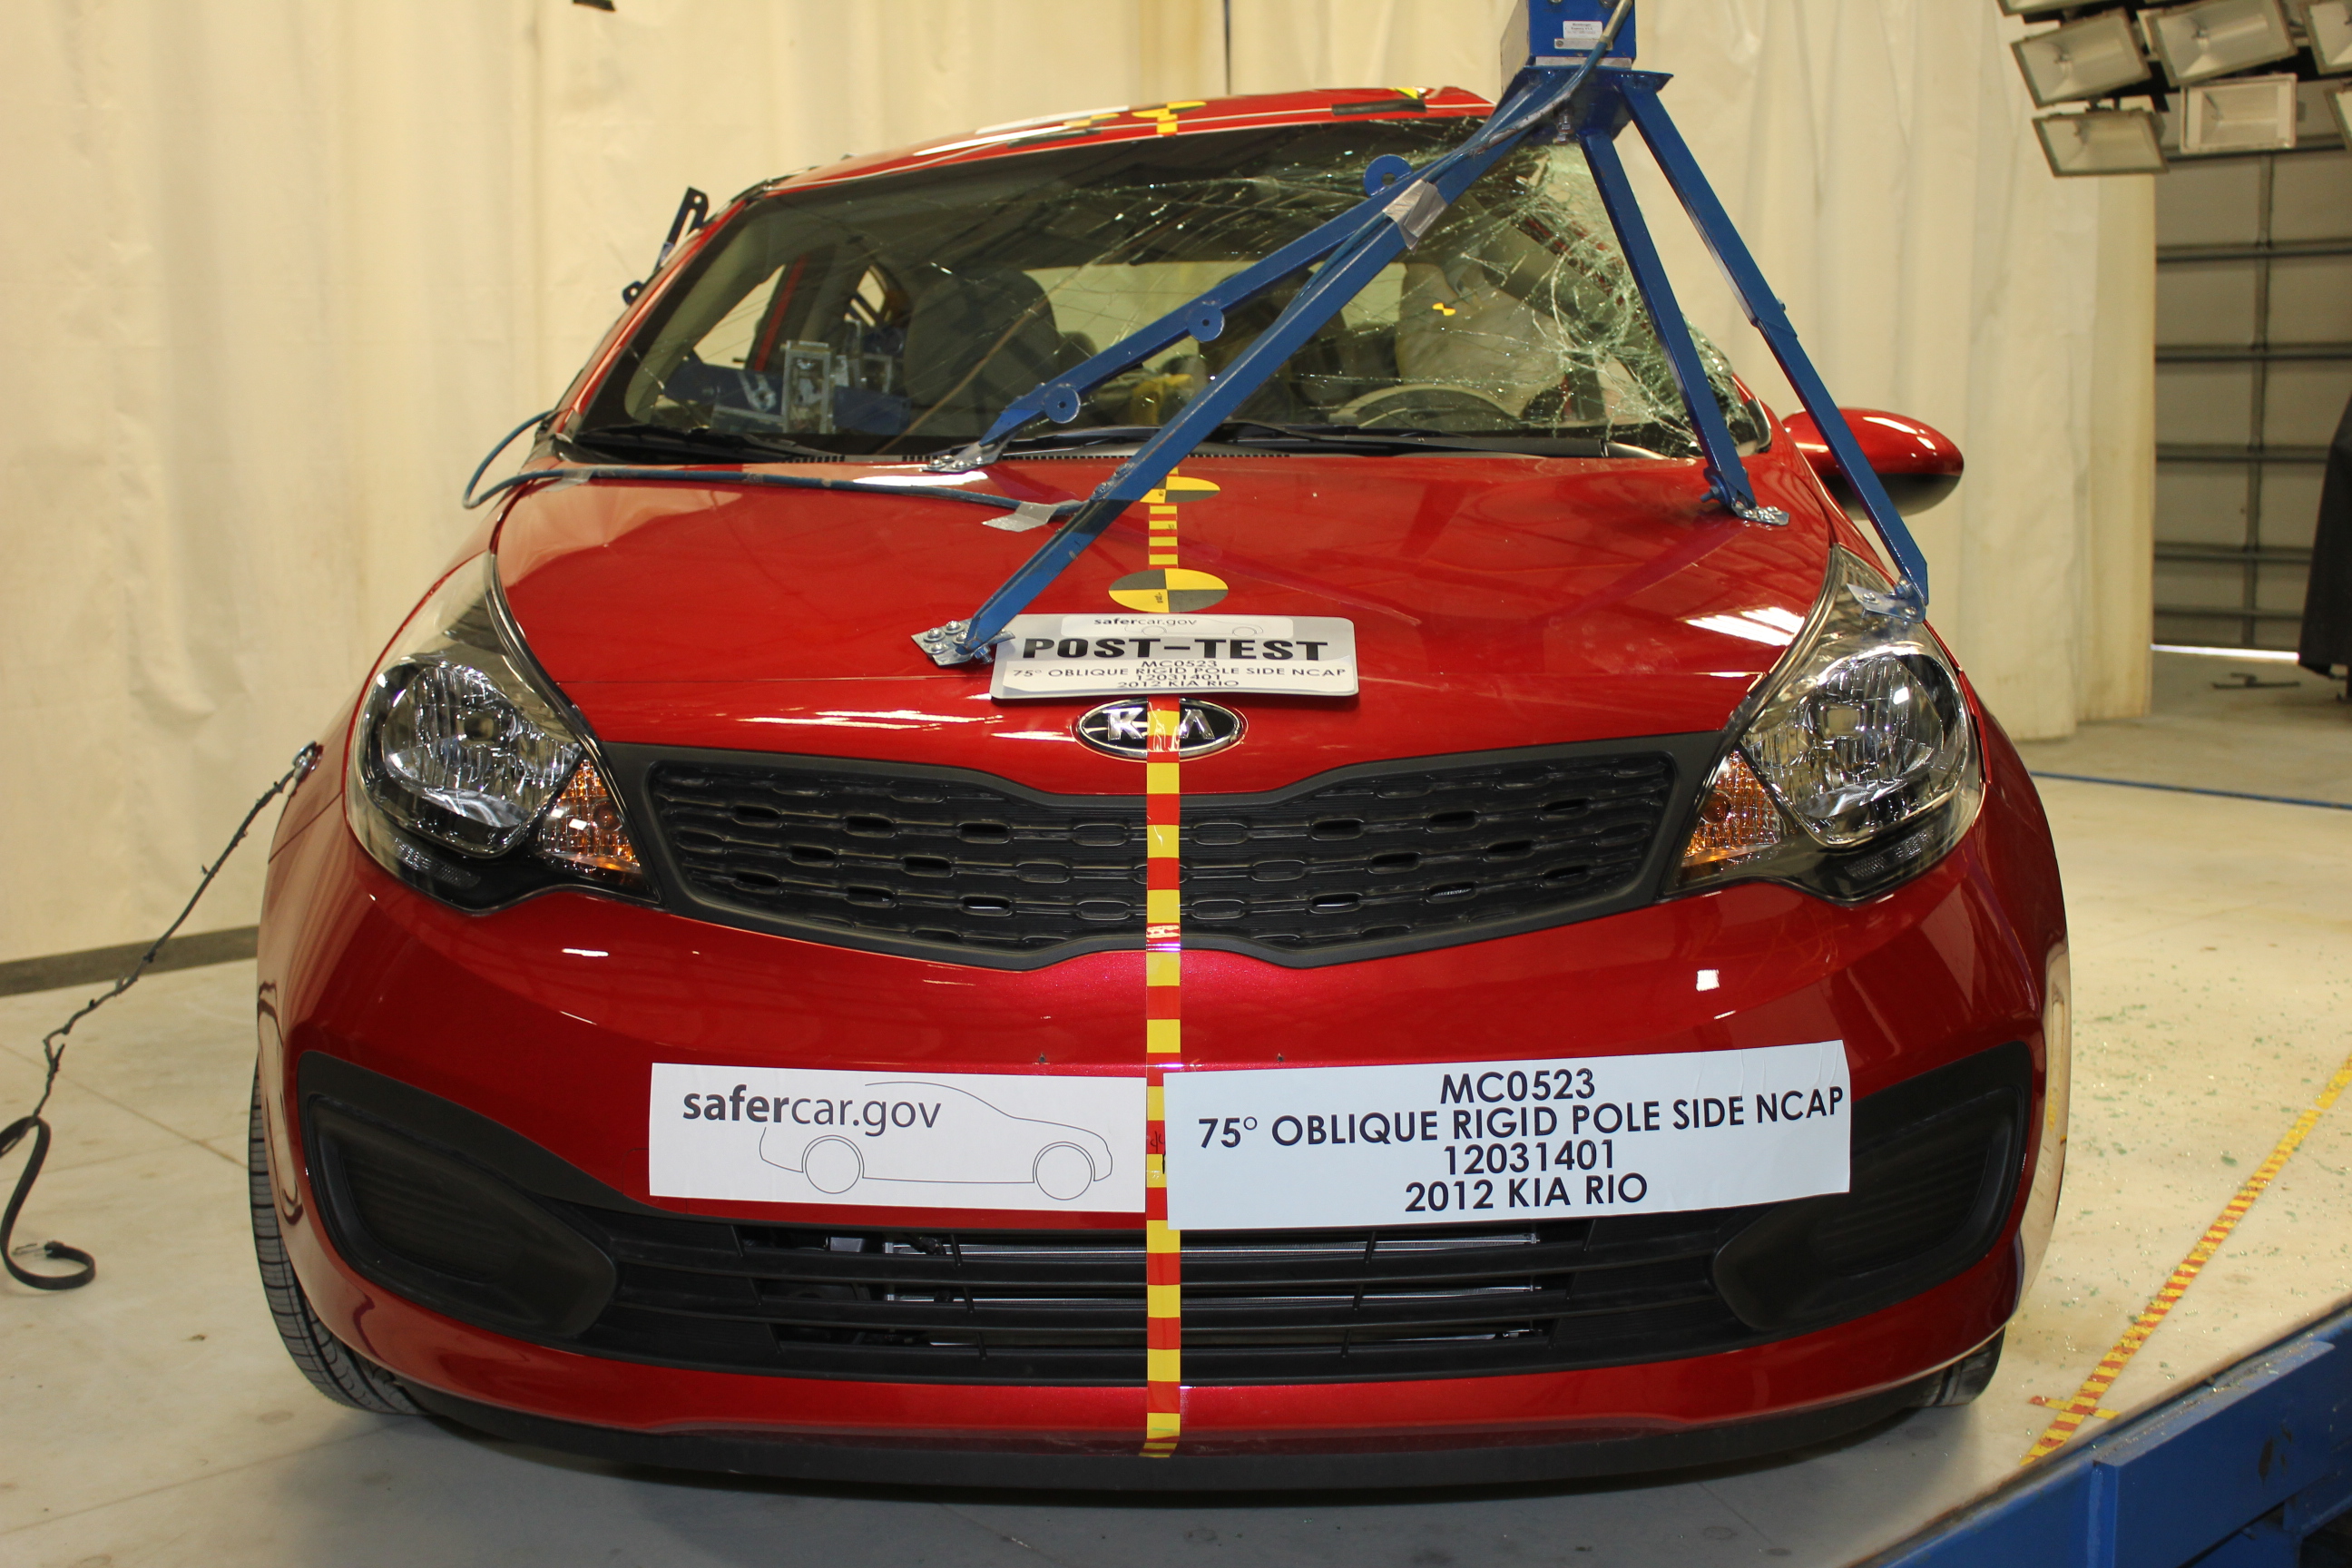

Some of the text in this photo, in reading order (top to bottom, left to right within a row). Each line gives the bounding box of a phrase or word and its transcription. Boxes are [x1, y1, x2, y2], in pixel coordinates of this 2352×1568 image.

[1094, 617, 1197, 627] safercar.gov
[1023, 638, 1328, 661] POST-TEST
[1048, 669, 1129, 677] OBLIQUE
[1104, 709, 1216, 741] KA
[1439, 1067, 1596, 1104] MC0523
[682, 1084, 942, 1137] safercar.gov
[1198, 1114, 1258, 1149] 75°
[1270, 1109, 1439, 1147] OBLIQUE
[1454, 1104, 1563, 1140] RIGID
[1573, 1101, 1661, 1135] POLE
[1672, 1095, 1744, 1129] SIDE
[1756, 1086, 1845, 1123] NCAP
[1444, 1140, 1615, 1176] 12031401
[1405, 1172, 1648, 1213] 2012 KIA RIO
